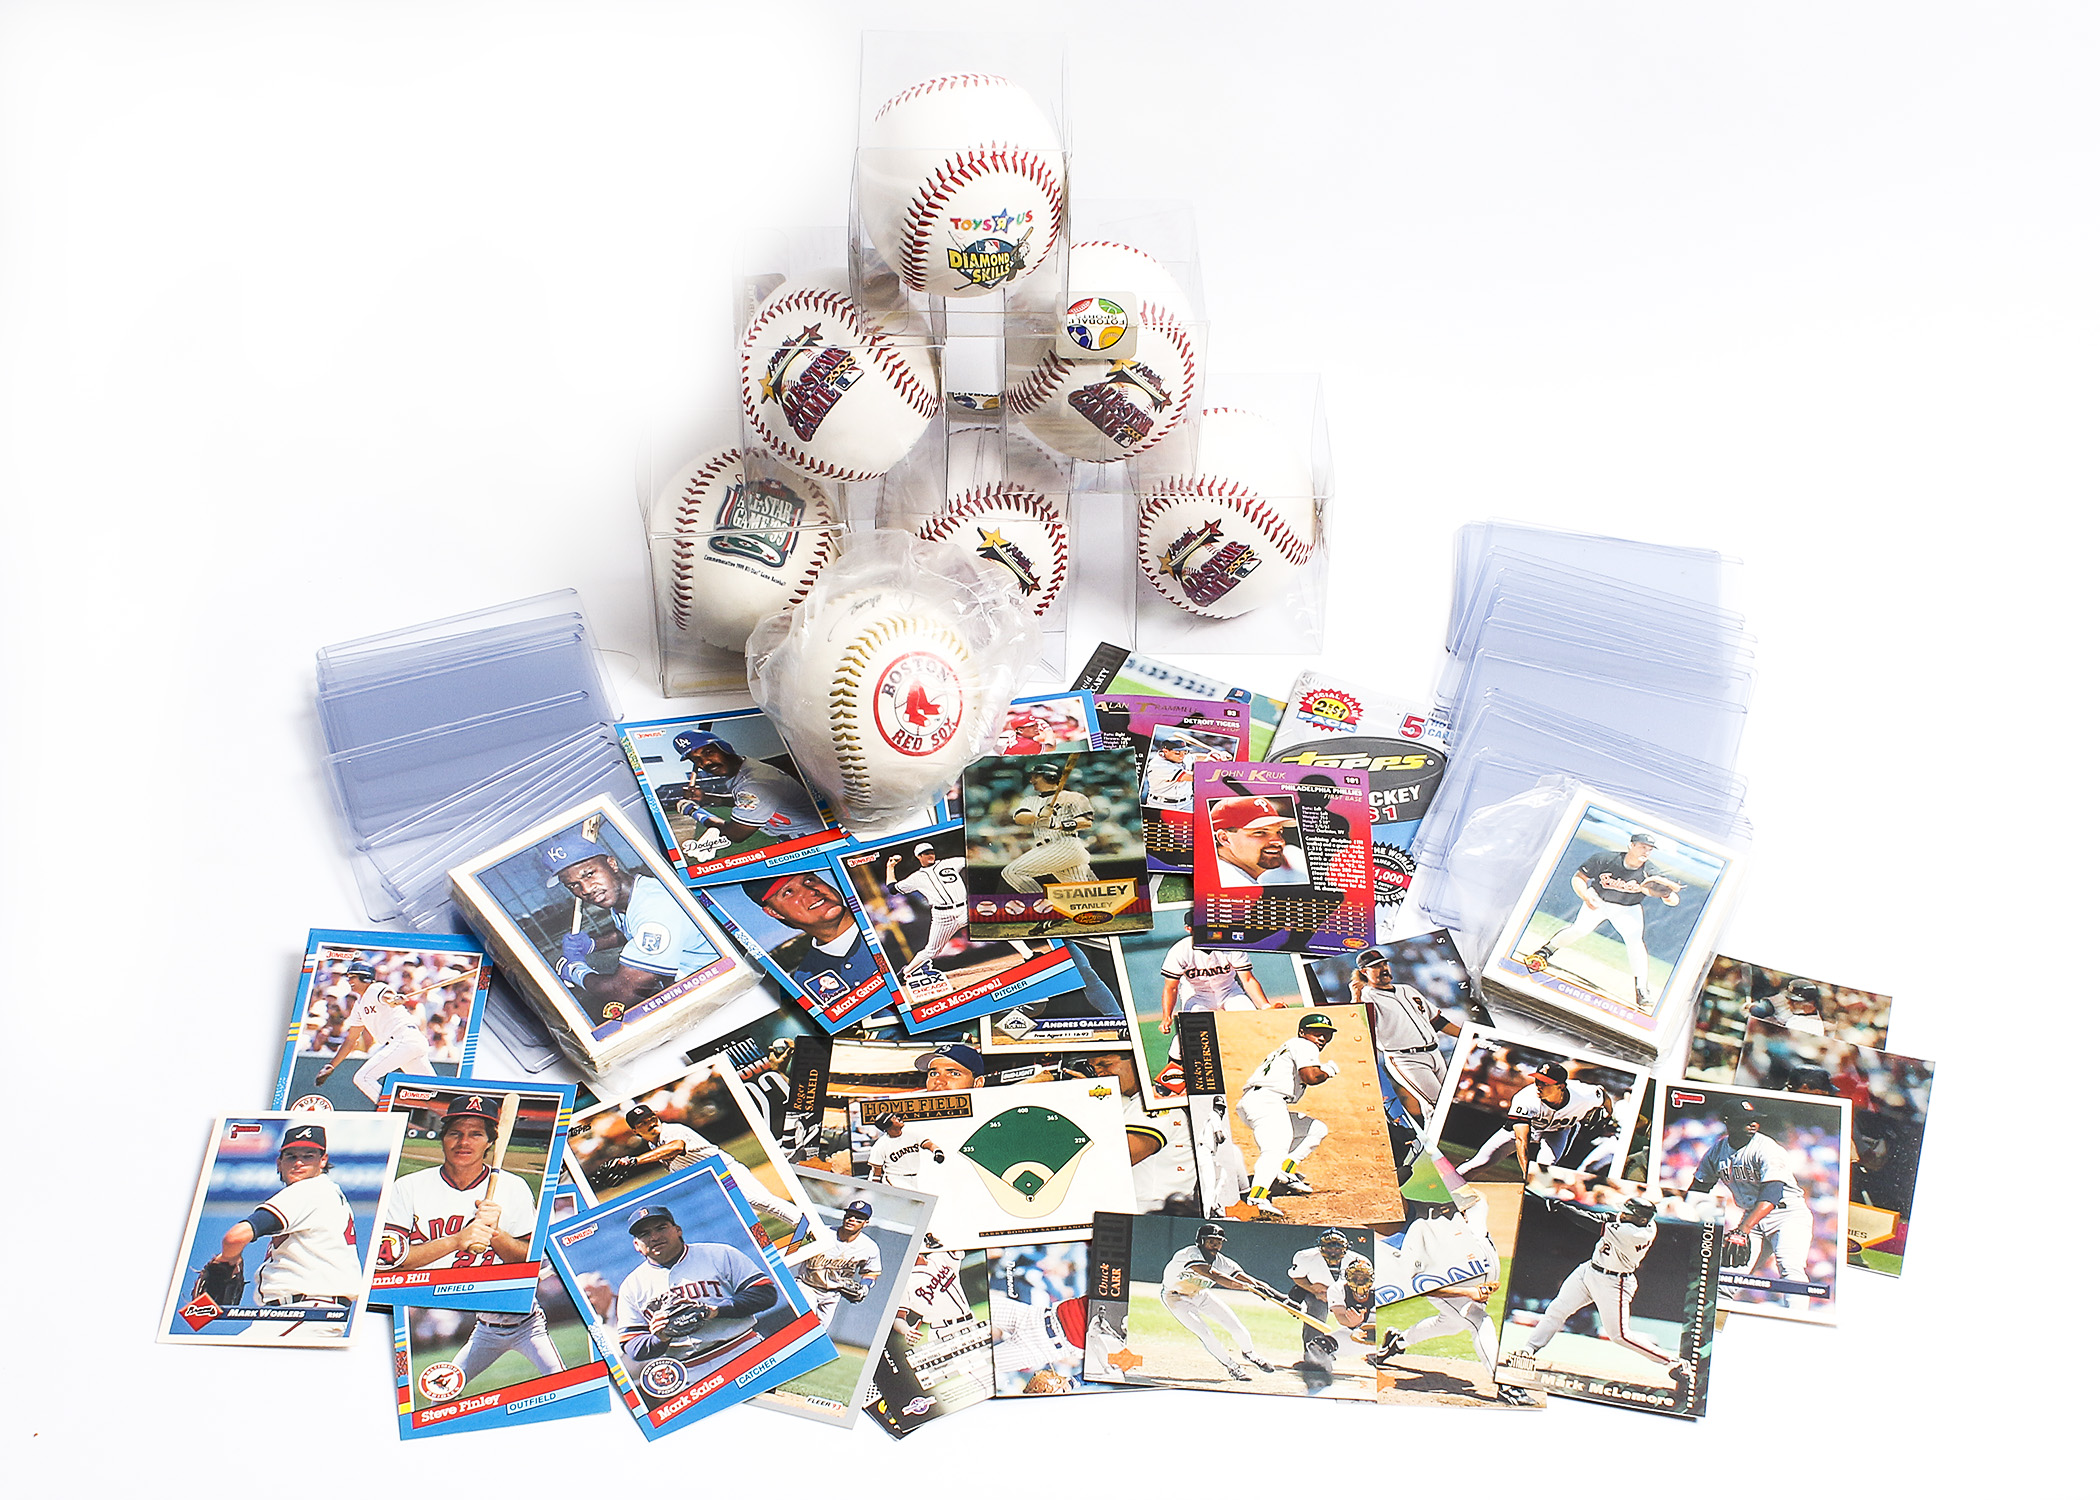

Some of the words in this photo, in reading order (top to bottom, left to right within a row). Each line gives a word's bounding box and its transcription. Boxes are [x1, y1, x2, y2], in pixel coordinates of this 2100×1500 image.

[950, 218, 992, 231] TOYS
[1016, 210, 1033, 225] US
[947, 248, 1010, 268] DIAMOND
[972, 262, 1010, 283] SKILLS
[882, 658, 950, 699] BOSTON
[1305, 691, 1341, 705] SPECIAL
[1342, 694, 1360, 719] VALUE
[1183, 717, 1215, 727] DETROIT
[1215, 719, 1241, 729] TIGERS
[1297, 710, 1357, 733] PACK
[1400, 714, 1426, 739] 5
[891, 729, 923, 751] RED
[931, 718, 959, 748] SOX
[1204, 769, 1244, 783] JOHN
[1248, 769, 1286, 782] KRUK
[1280, 784, 1332, 794] PHILADELPHIA
[1332, 787, 1363, 797] PHILLIES
[1323, 793, 1344, 801] FIRST
[685, 836, 730, 852] Dodgers
[696, 860, 724, 876] Juan
[725, 850, 767, 870] Samuel
[768, 853, 802, 866] SECOND
[801, 847, 822, 859] BASE
[1373, 868, 1404, 885] 1,000
[1052, 884, 1128, 899] STANLEY
[1069, 902, 1113, 911] STANLEY
[909, 973, 945, 989] SOX
[1185, 963, 1231, 979] GIANTS
[641, 986, 683, 1013] KERWIN
[682, 966, 720, 991] MOORE
[830, 995, 859, 1017] Mark
[855, 975, 885, 998] Grant
[912, 983, 948, 994] CHICAGO
[920, 1000, 948, 1018] Jack
[949, 978, 1003, 1005] McDowell
[994, 980, 1028, 999] PITCHER
[1557, 982, 1592, 1004] CHRIS
[1593, 998, 1635, 1020] HOILES
[1042, 1020, 1078, 1029] ANDRES
[1199, 1030, 1217, 1090] HENDERSON
[793, 1083, 805, 1111] Roger
[805, 1068, 818, 1112] SALKELD
[864, 1101, 915, 1116] HOME
[920, 1096, 968, 1111] FIELD
[889, 1143, 920, 1163] GIANTS
[405, 1272, 431, 1284] Hill
[437, 1283, 475, 1293] INFIELD
[1098, 1262, 1109, 1297] Chuck
[1110, 1268, 1122, 1298] CARR
[1733, 1275, 1772, 1289] HARRIS
[227, 1308, 258, 1318] MARK
[259, 1308, 306, 1319] WOHLERS
[326, 1310, 345, 1319] RHP
[738, 1357, 777, 1385] CATCHER
[657, 1396, 691, 1421] Mark
[689, 1375, 725, 1401] Salas
[1541, 1373, 1586, 1393] Mark
[1587, 1382, 1676, 1409] McLemore
[421, 1405, 458, 1423] Steve
[459, 1393, 501, 1412] Finley
[509, 1392, 557, 1412] OUTFIELD
[807, 1396, 831, 1408] FLEER
